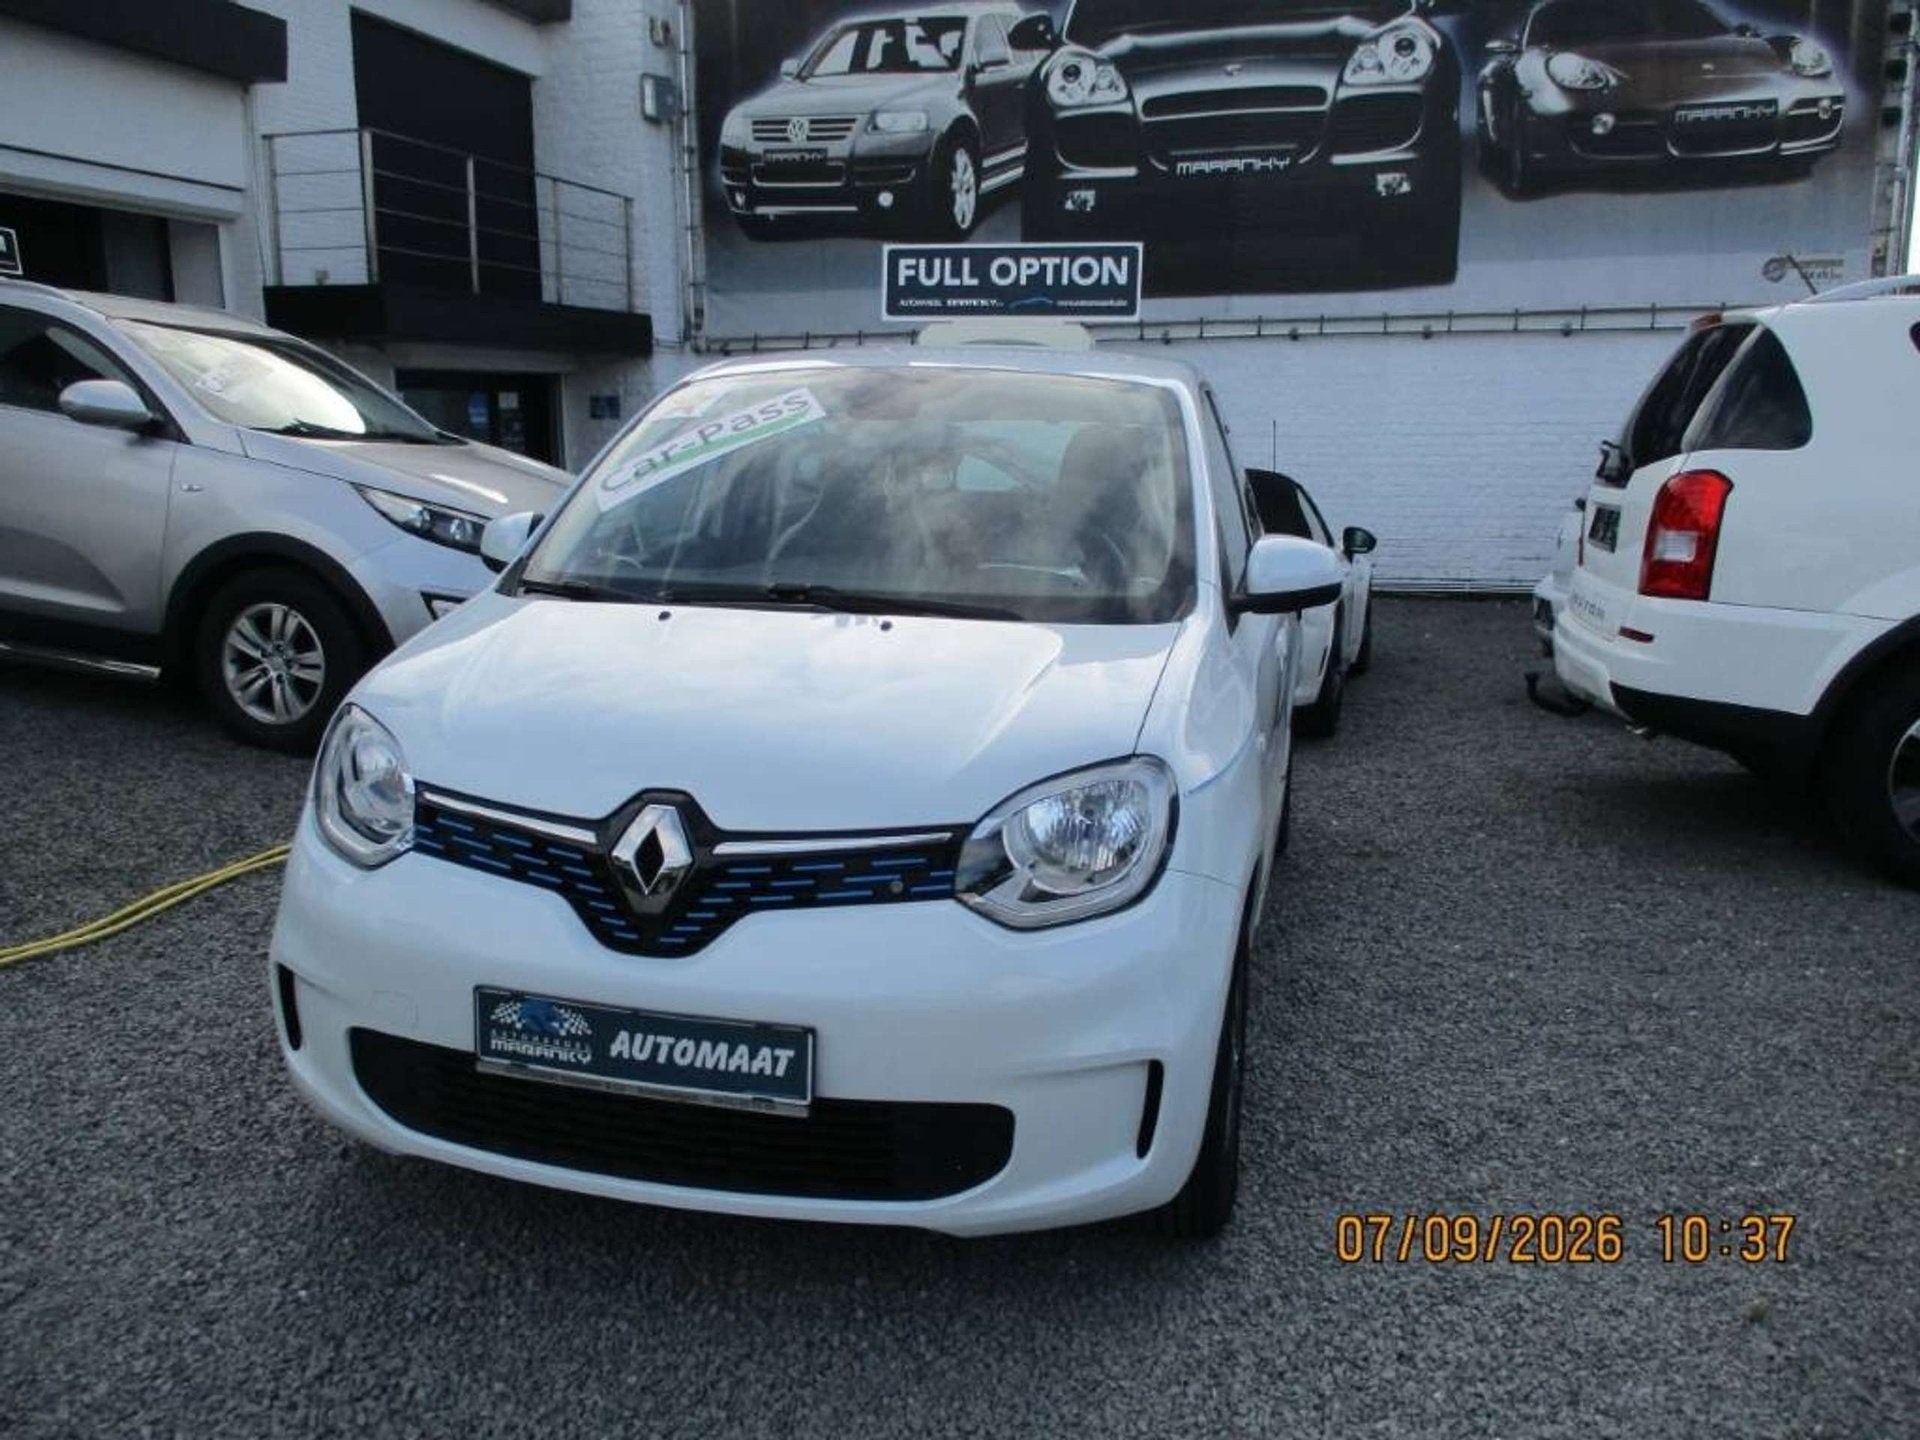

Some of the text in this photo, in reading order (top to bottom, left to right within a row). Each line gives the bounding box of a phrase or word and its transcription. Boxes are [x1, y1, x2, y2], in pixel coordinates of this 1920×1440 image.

[897, 256, 1129, 287] FULL OPTION
[601, 393, 812, 492] Car-Pass
[610, 1029, 795, 1079] AUTOMAAT
